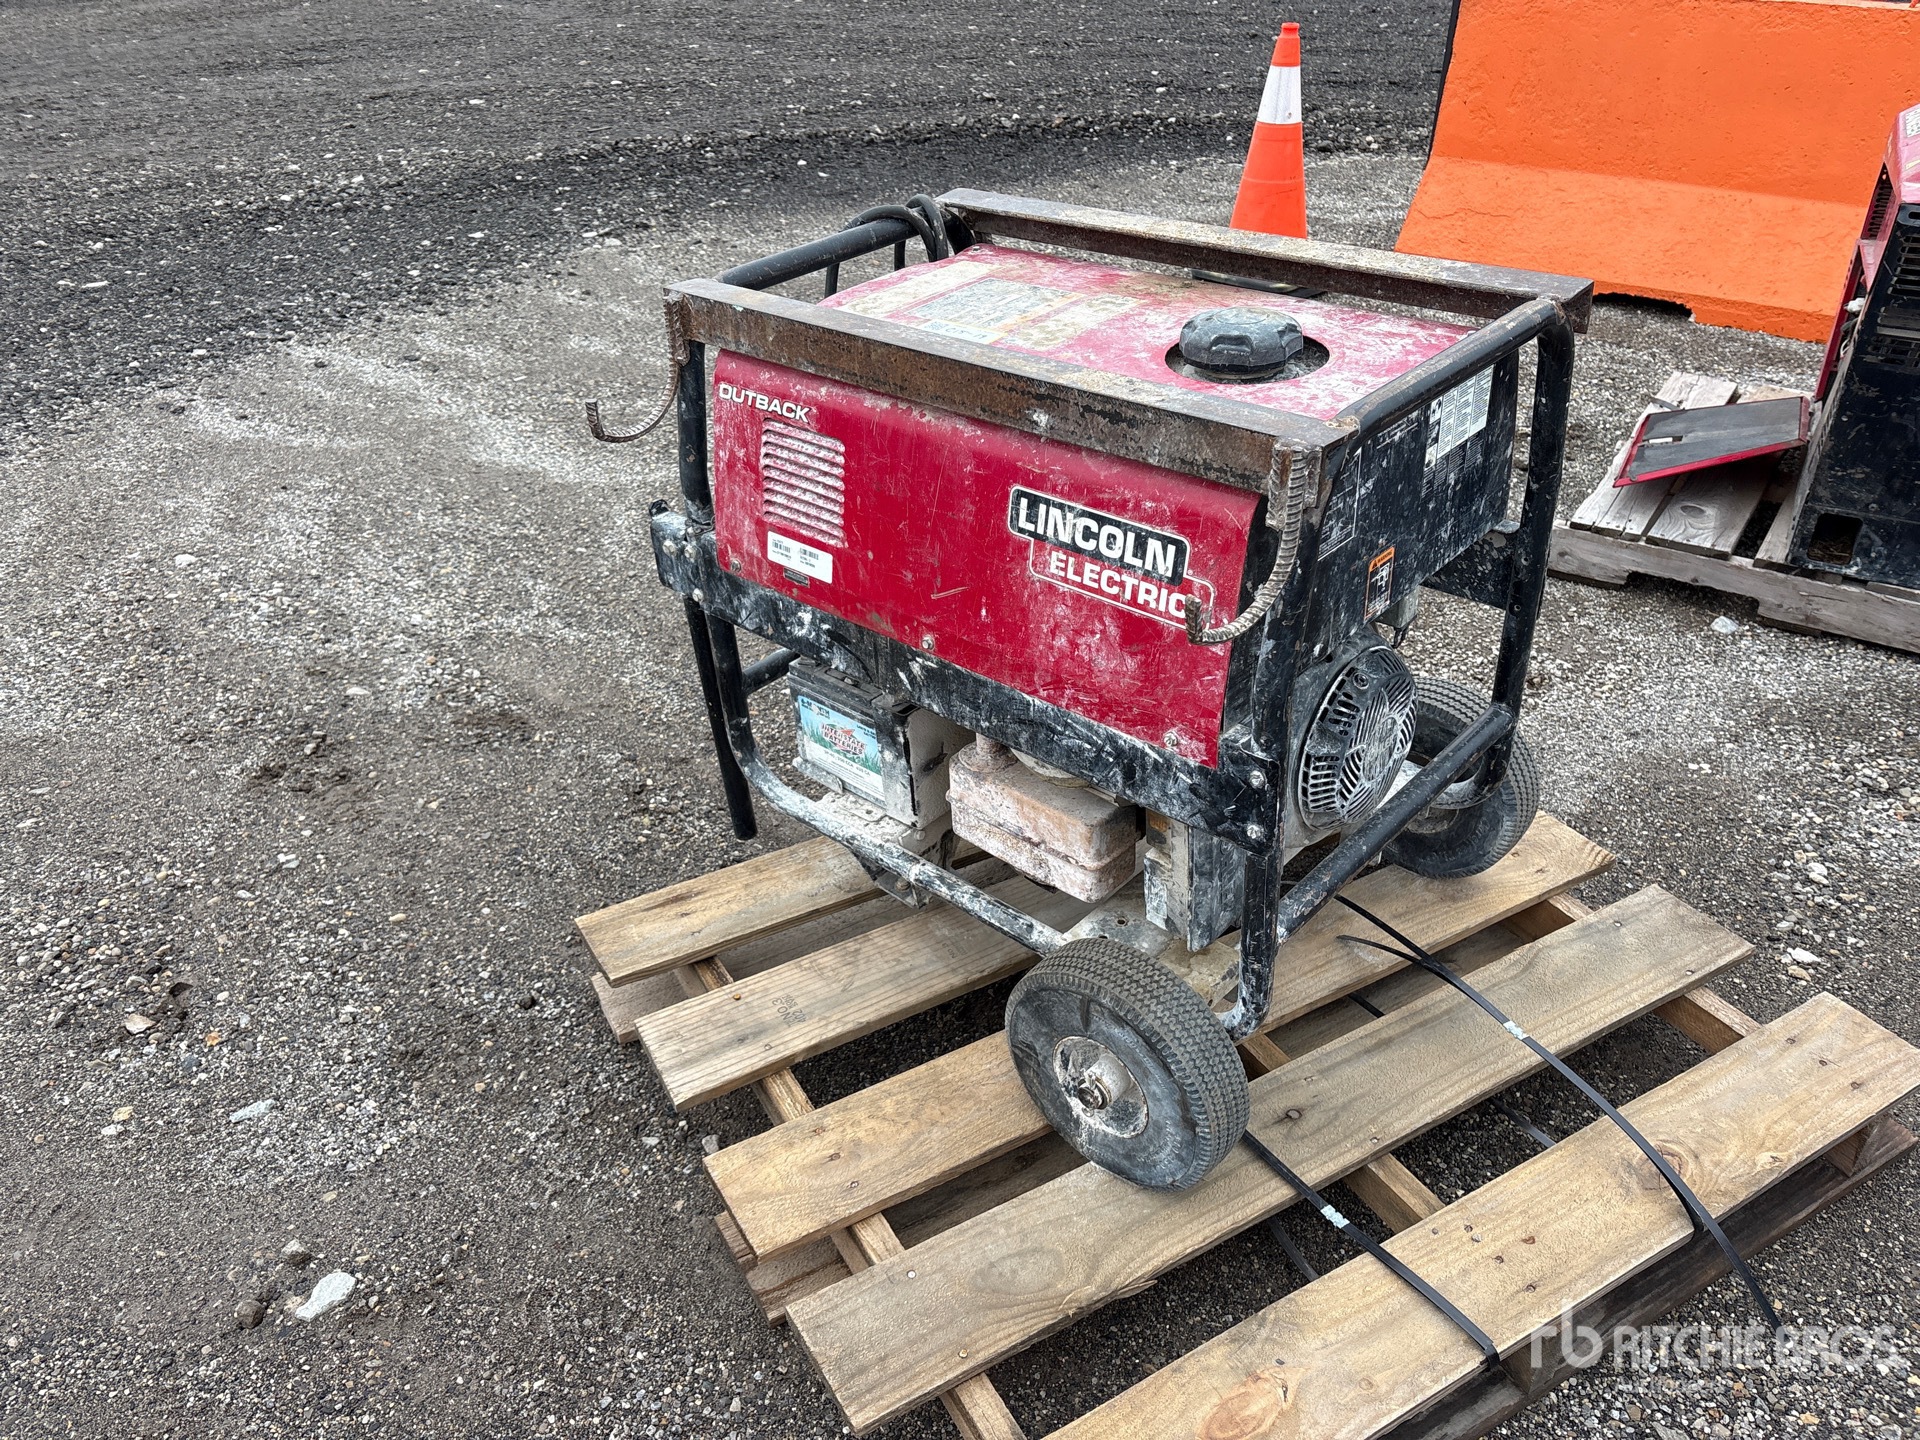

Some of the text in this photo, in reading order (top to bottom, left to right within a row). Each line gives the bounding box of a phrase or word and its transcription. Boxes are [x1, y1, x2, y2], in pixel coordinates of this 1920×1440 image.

[719, 383, 810, 423] OUTBACK
[1018, 497, 1177, 578] LINCOLN
[1049, 551, 1188, 619] ELECTRIC
[822, 723, 865, 748] INTERSTATE
[824, 732, 863, 755] BATTERIES
